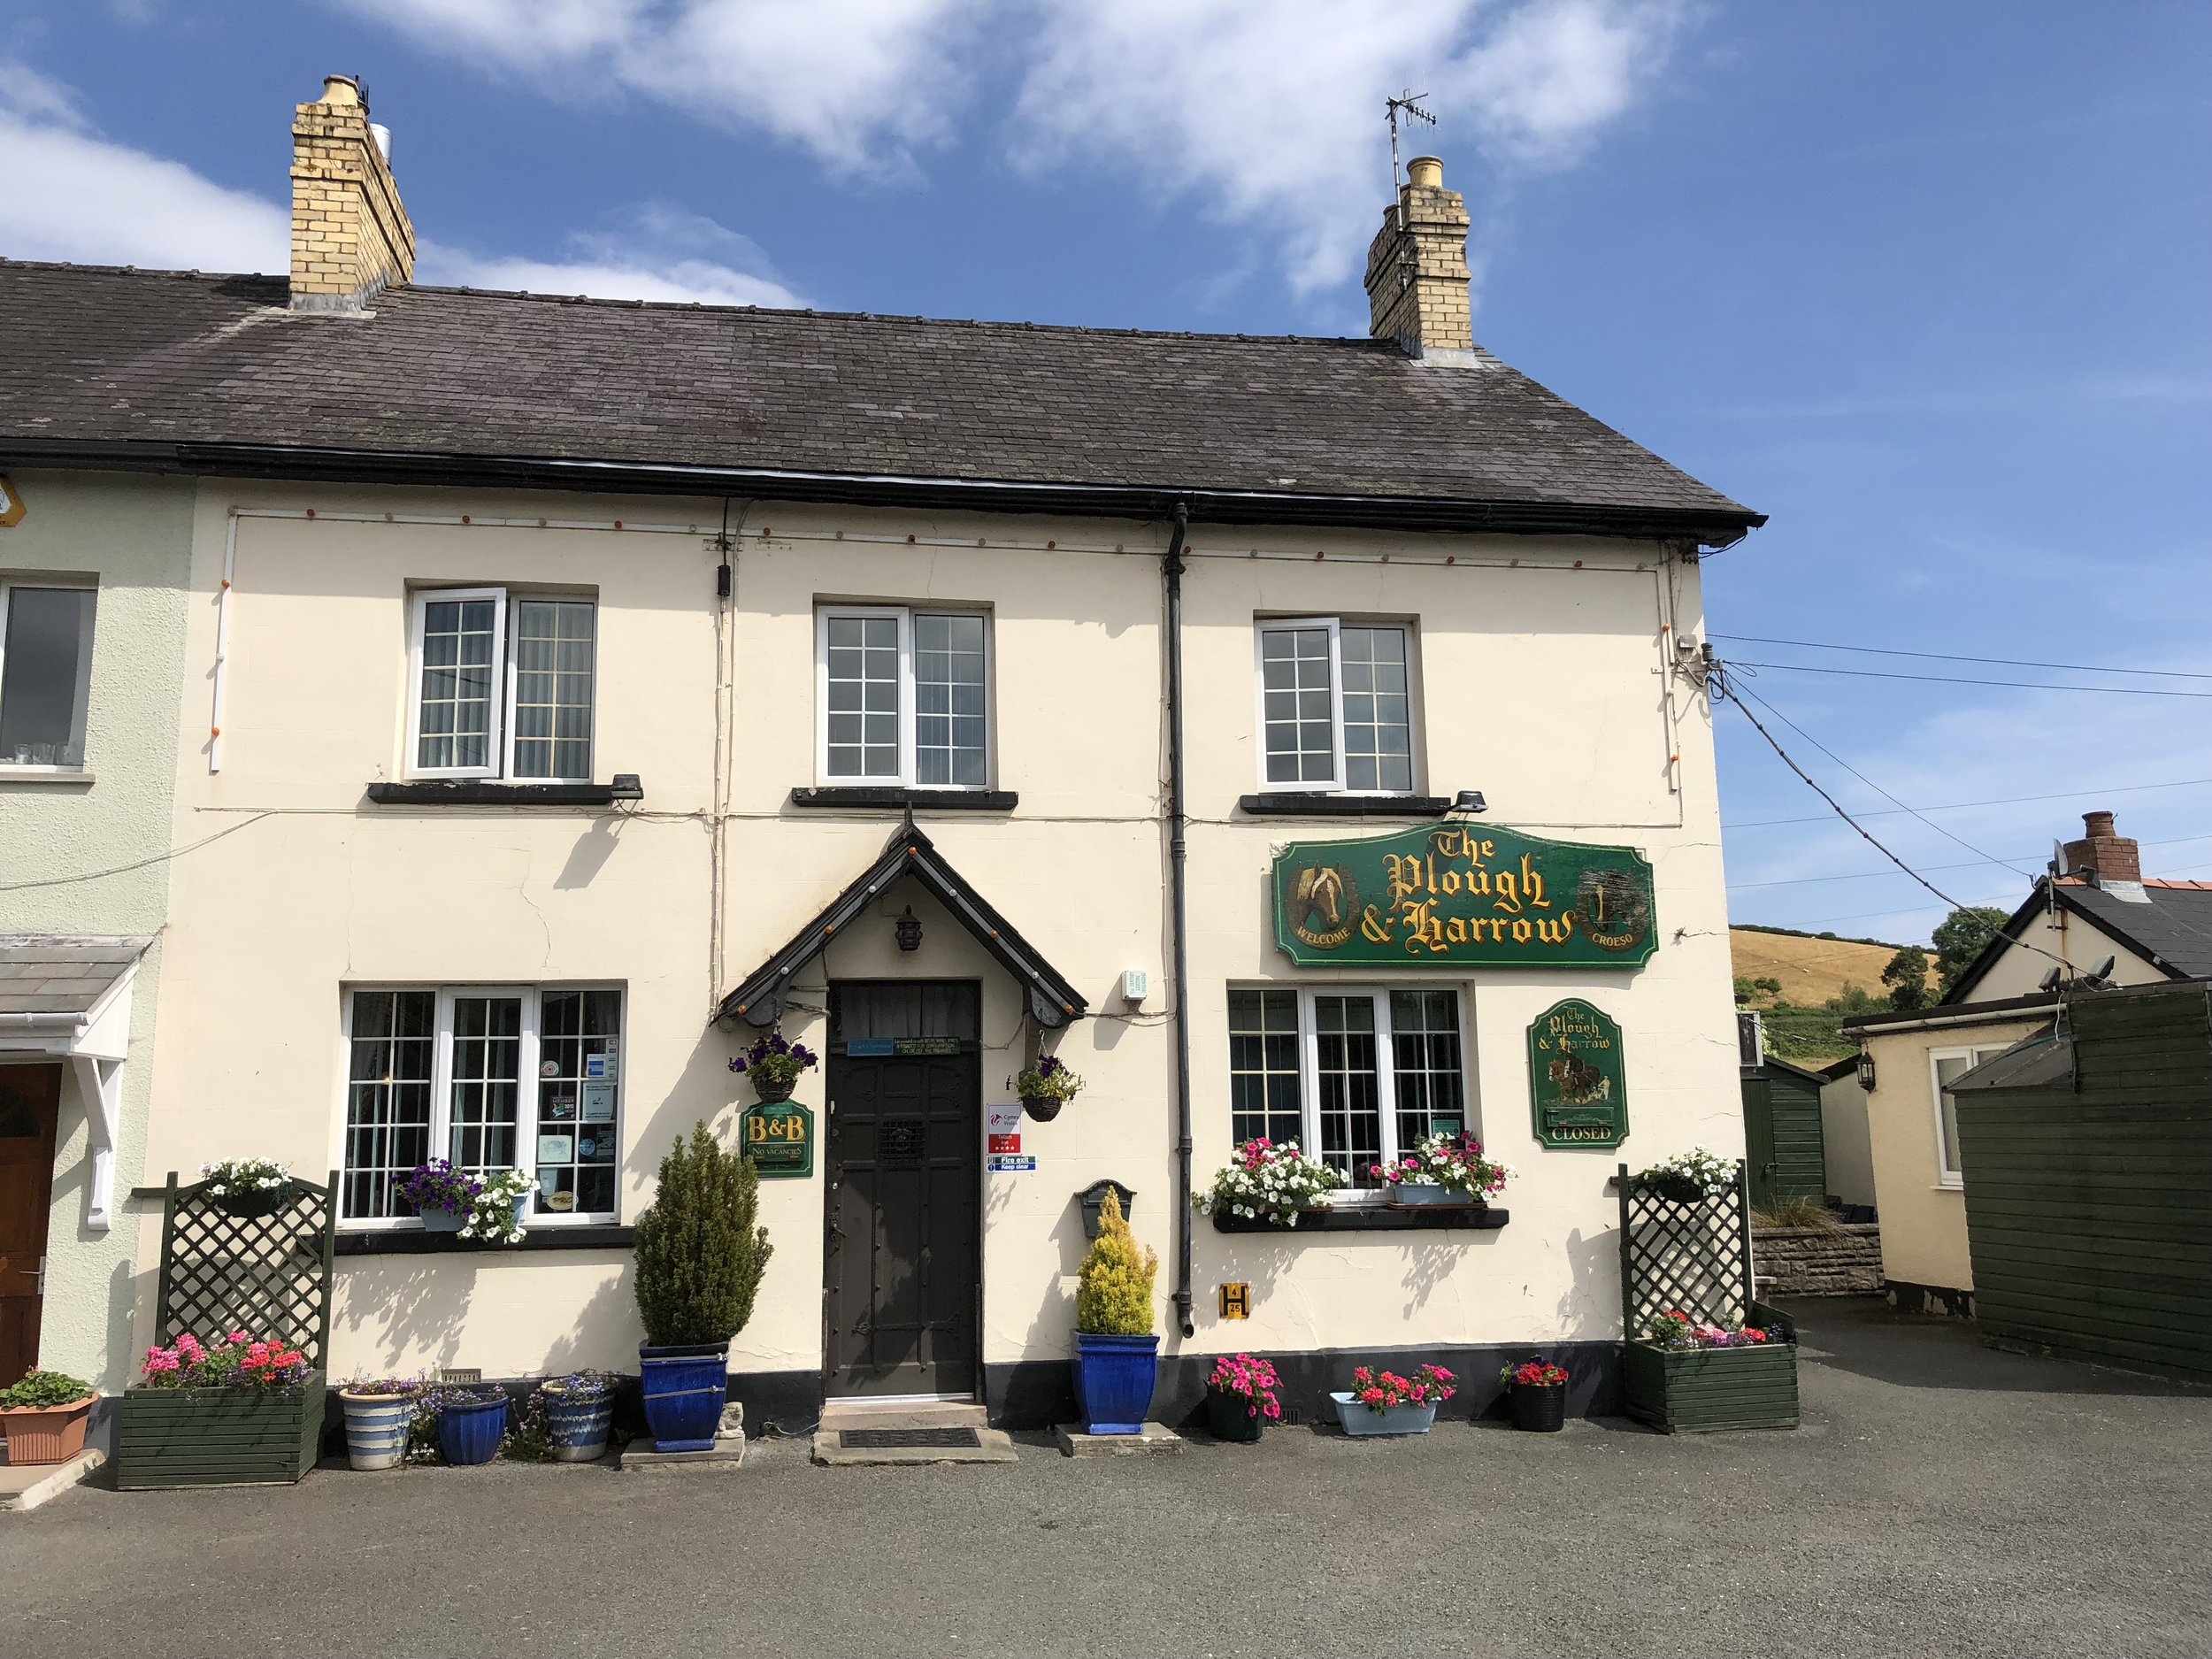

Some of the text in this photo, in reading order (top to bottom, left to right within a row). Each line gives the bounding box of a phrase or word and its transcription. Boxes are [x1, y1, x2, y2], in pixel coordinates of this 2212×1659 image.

[1428, 827, 1497, 869] The
[1382, 851, 1552, 915] Plough
[1297, 926, 1351, 945] WELCOME
[1361, 897, 1579, 956] & Harrow
[1592, 933, 1633, 948] CROESO
[1548, 1014, 1602, 1039] Plough
[1563, 1005, 1585, 1024] The
[1539, 1033, 1610, 1054] & Harrow
[749, 1115, 805, 1142] B&B
[1552, 1126, 1611, 1141] CLOSED
[1224, 1286, 1245, 1316] H
